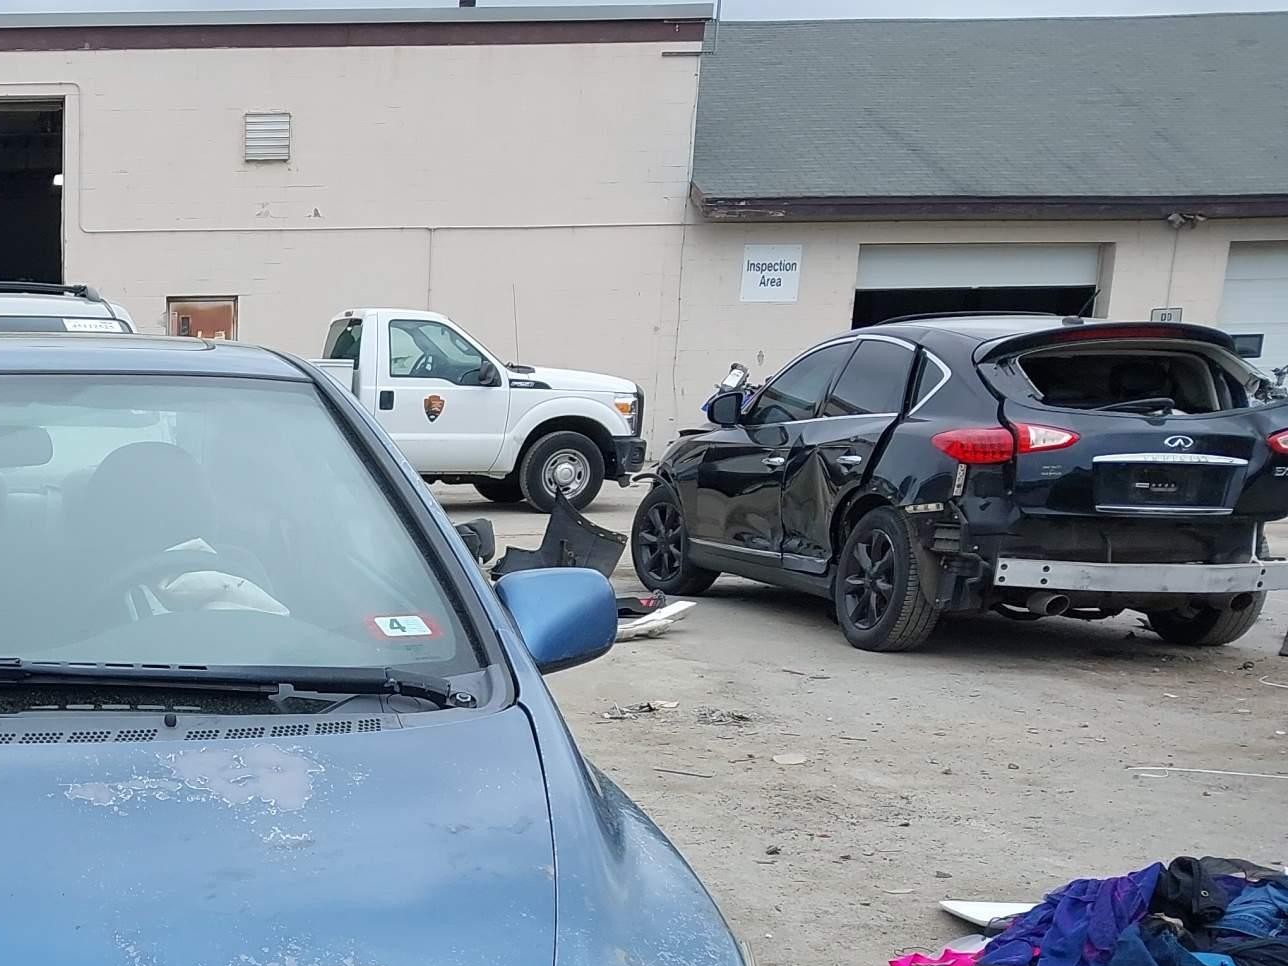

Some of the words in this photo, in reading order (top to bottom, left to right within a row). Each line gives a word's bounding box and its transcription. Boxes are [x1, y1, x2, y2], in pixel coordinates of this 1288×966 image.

[746, 259, 797, 274] Inspection
[759, 275, 782, 287] Area
[389, 618, 406, 632] 4
